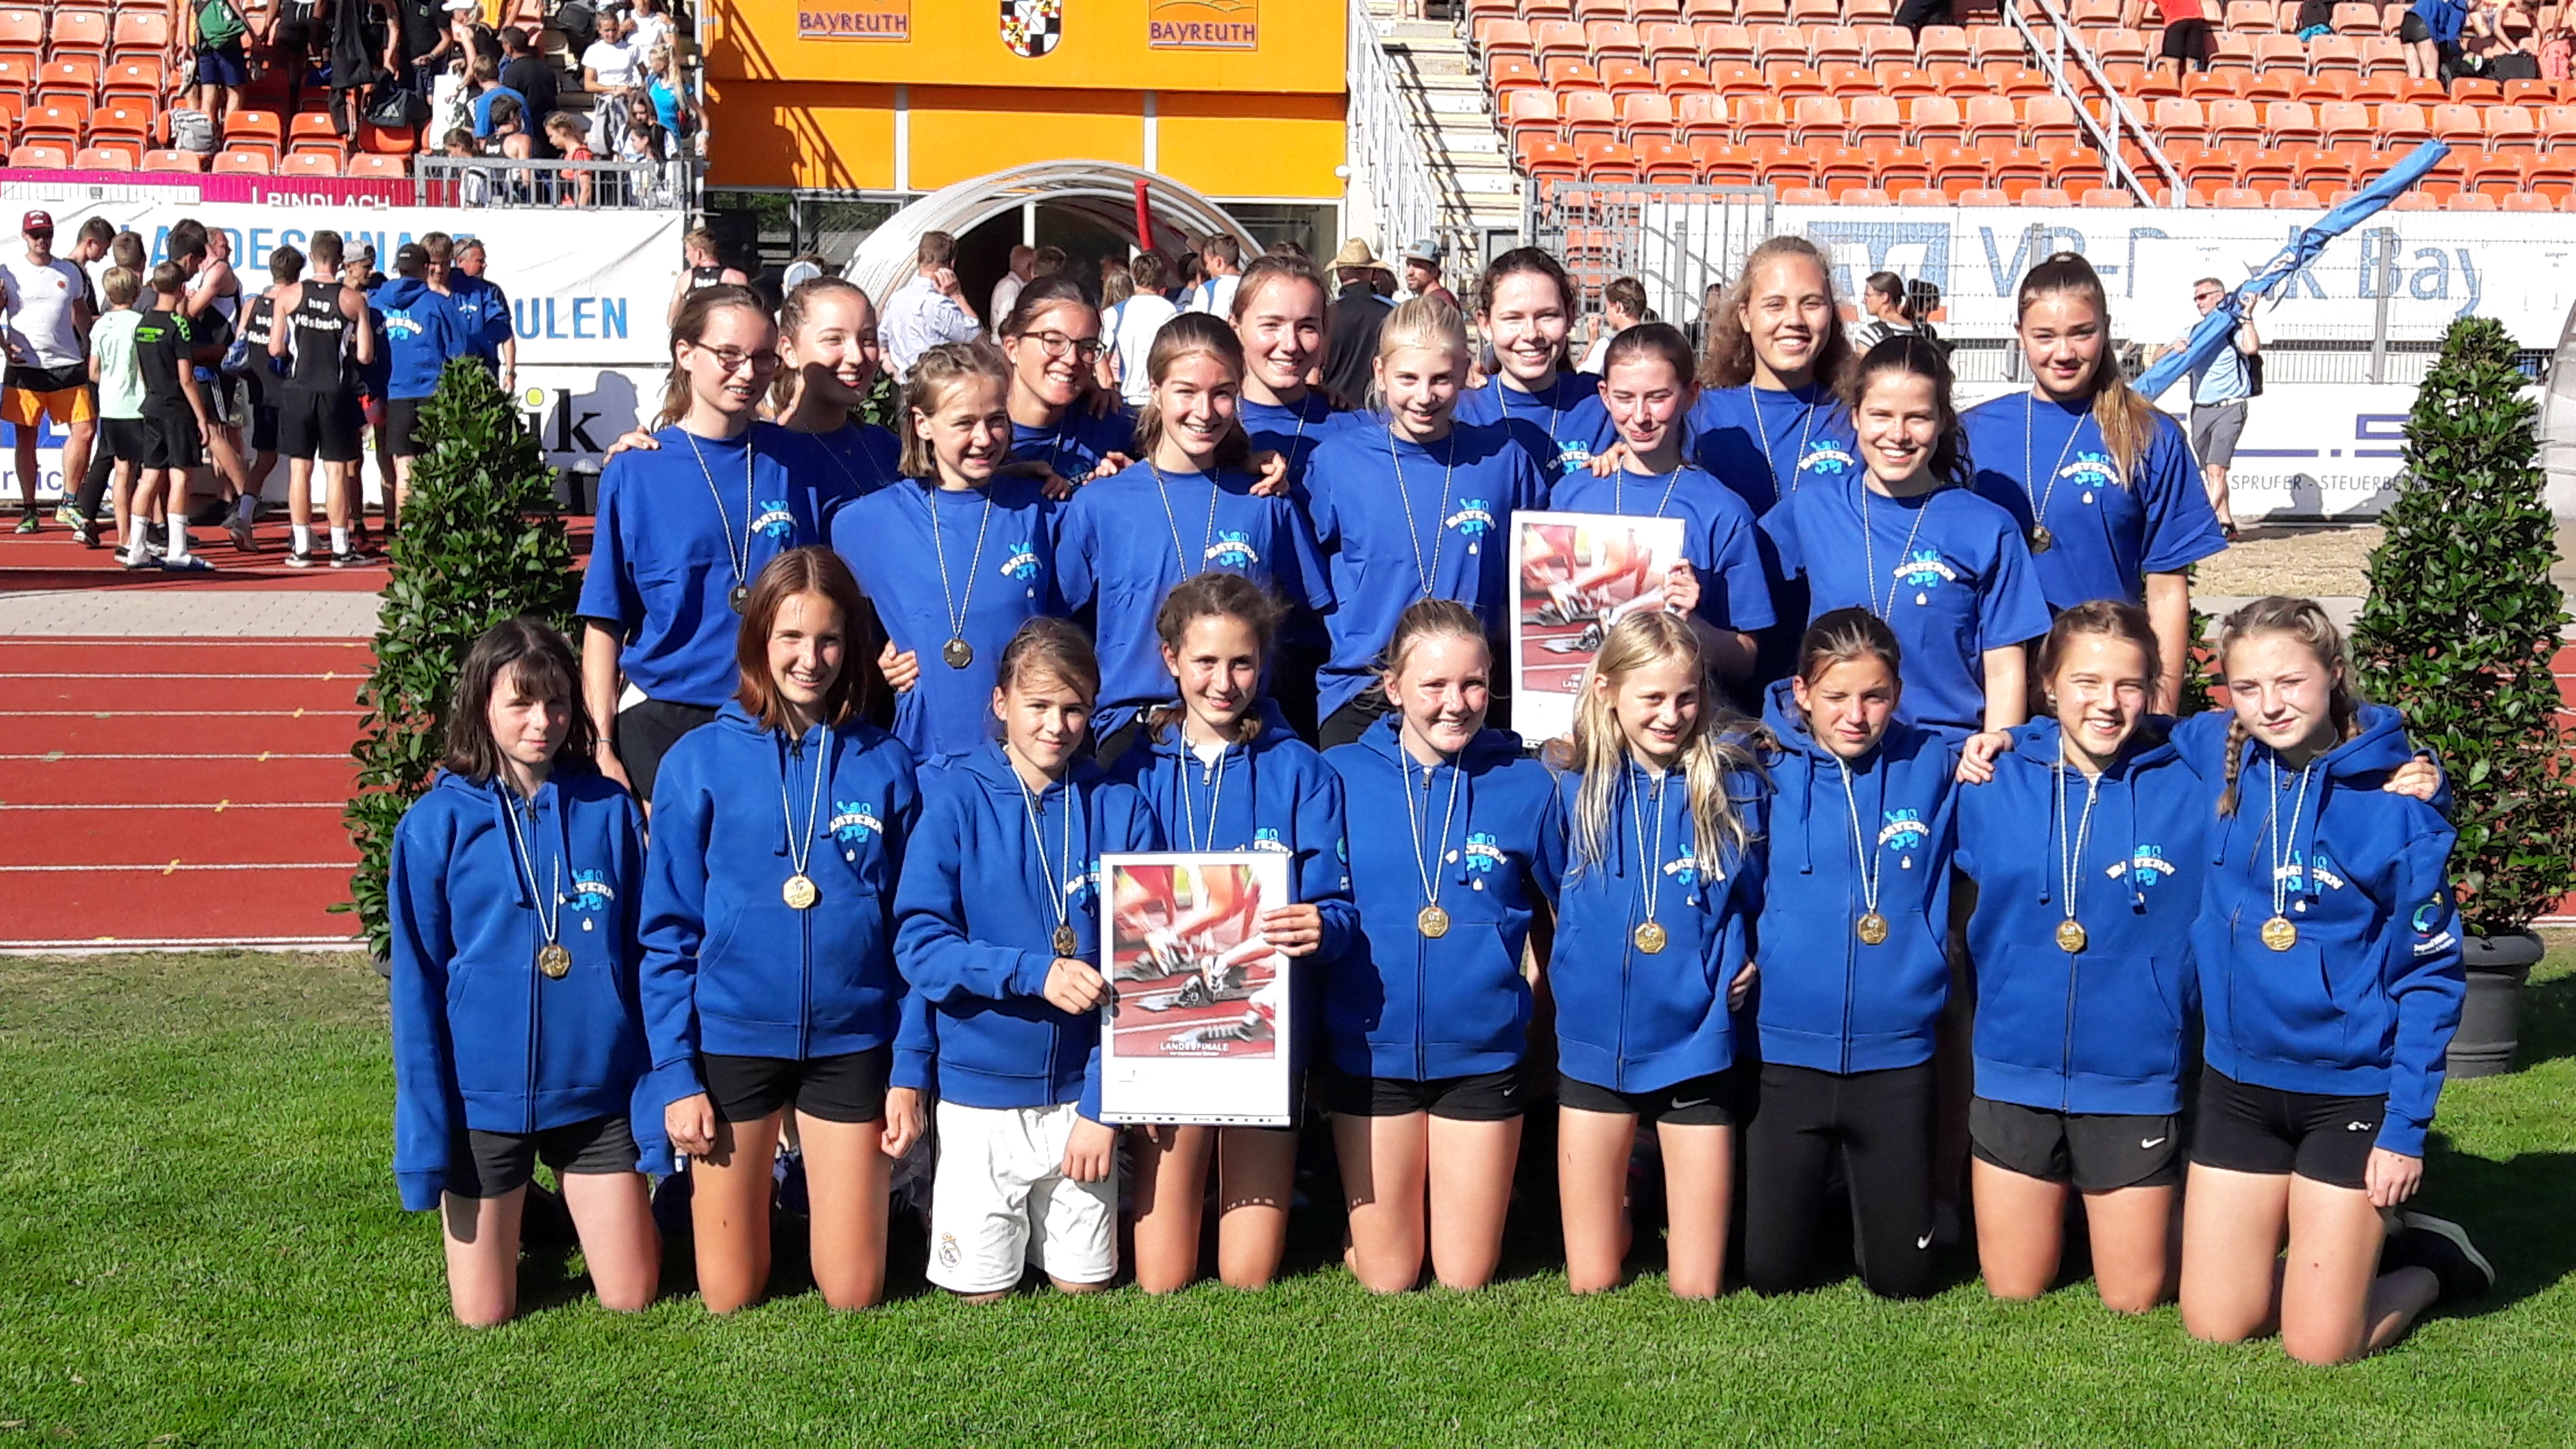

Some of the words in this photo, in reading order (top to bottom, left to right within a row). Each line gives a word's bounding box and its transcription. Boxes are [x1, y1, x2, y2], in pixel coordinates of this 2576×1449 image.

[799, 12, 907, 34] BAYREUTH
[1150, 21, 1255, 44] BAYREUTH
[514, 297, 628, 339] ULEN
[523, 387, 603, 453] ik
